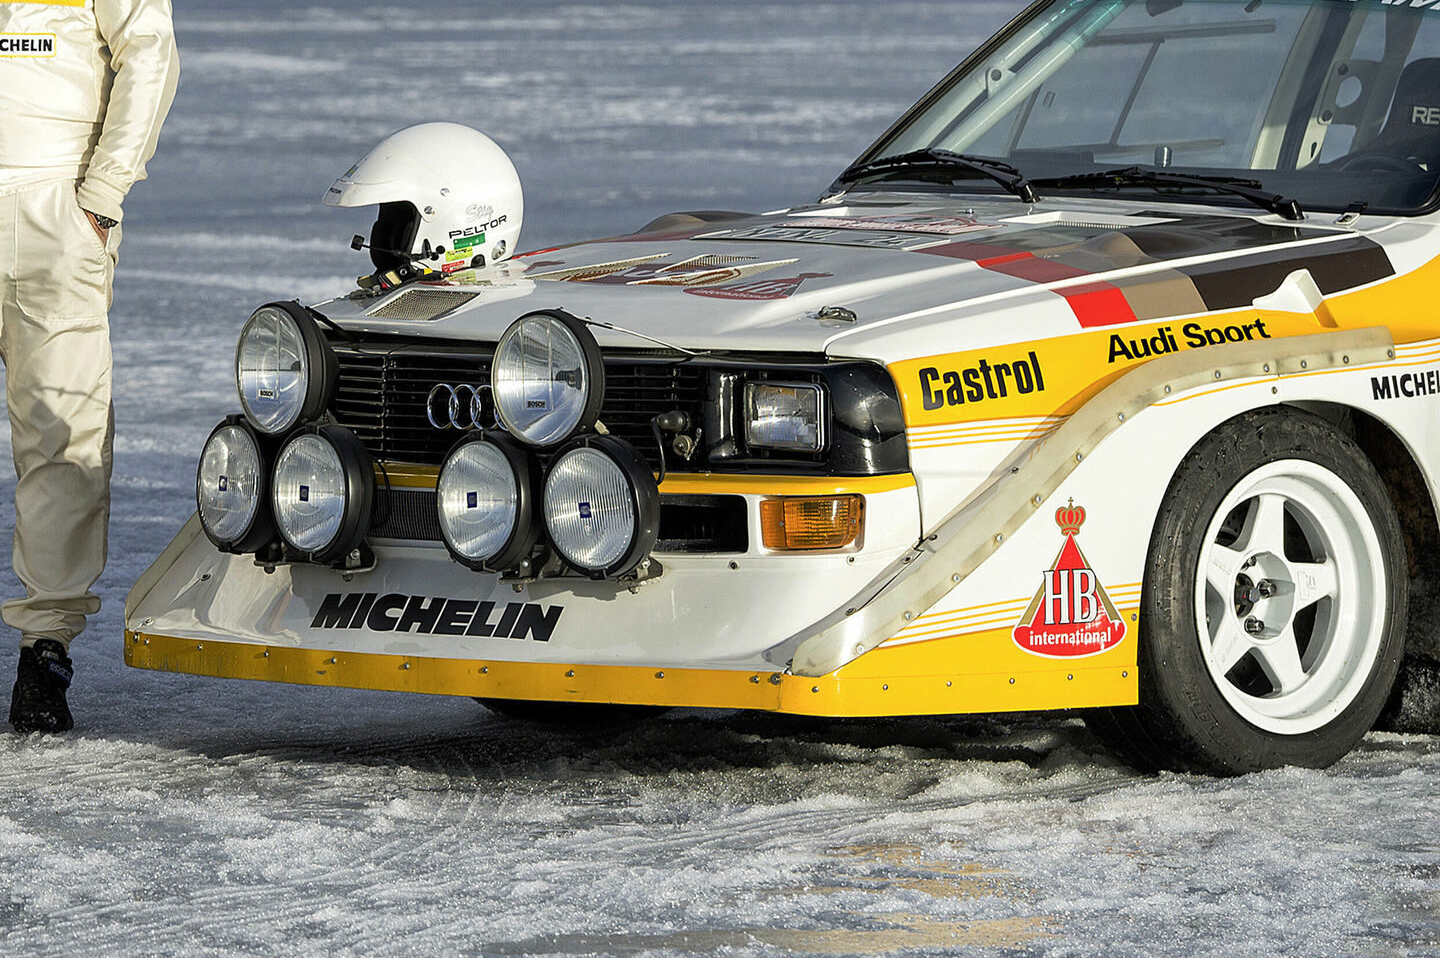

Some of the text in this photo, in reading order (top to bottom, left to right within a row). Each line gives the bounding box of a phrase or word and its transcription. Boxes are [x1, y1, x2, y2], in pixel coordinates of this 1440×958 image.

[449, 215, 507, 239] PELTOR
[1107, 317, 1272, 363] Audi Sport
[527, 400, 546, 408] BOSCH
[918, 352, 1045, 411] Castrol
[310, 592, 564, 642] MICHELIN
[1043, 568, 1098, 625] HB
[1029, 627, 1111, 646] international
